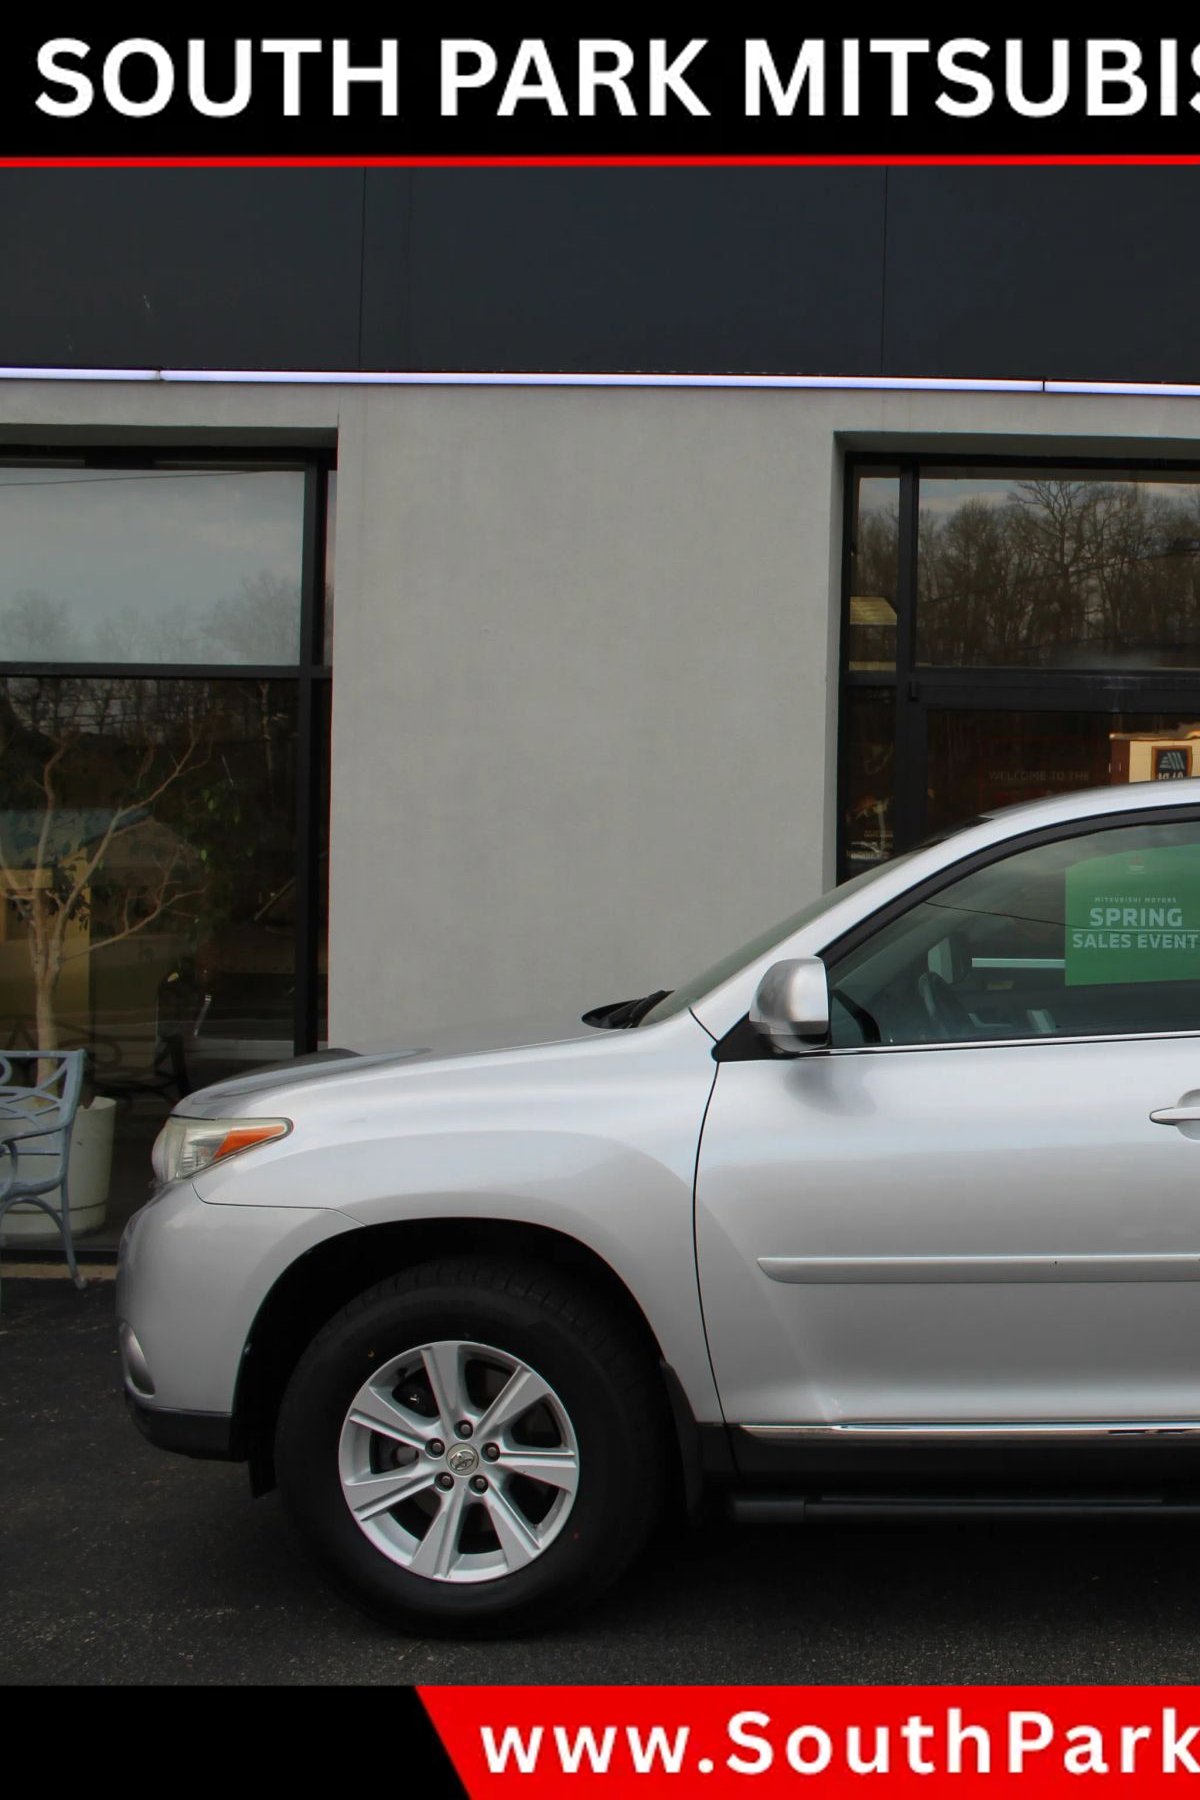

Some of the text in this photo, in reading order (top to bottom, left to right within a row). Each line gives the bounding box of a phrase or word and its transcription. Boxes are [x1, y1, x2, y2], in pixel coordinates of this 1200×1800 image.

[989, 770, 1089, 780] WELCOME TO THE
[1090, 908, 1182, 927] SPRING
[1073, 934, 1198, 949] SALES EVENT
